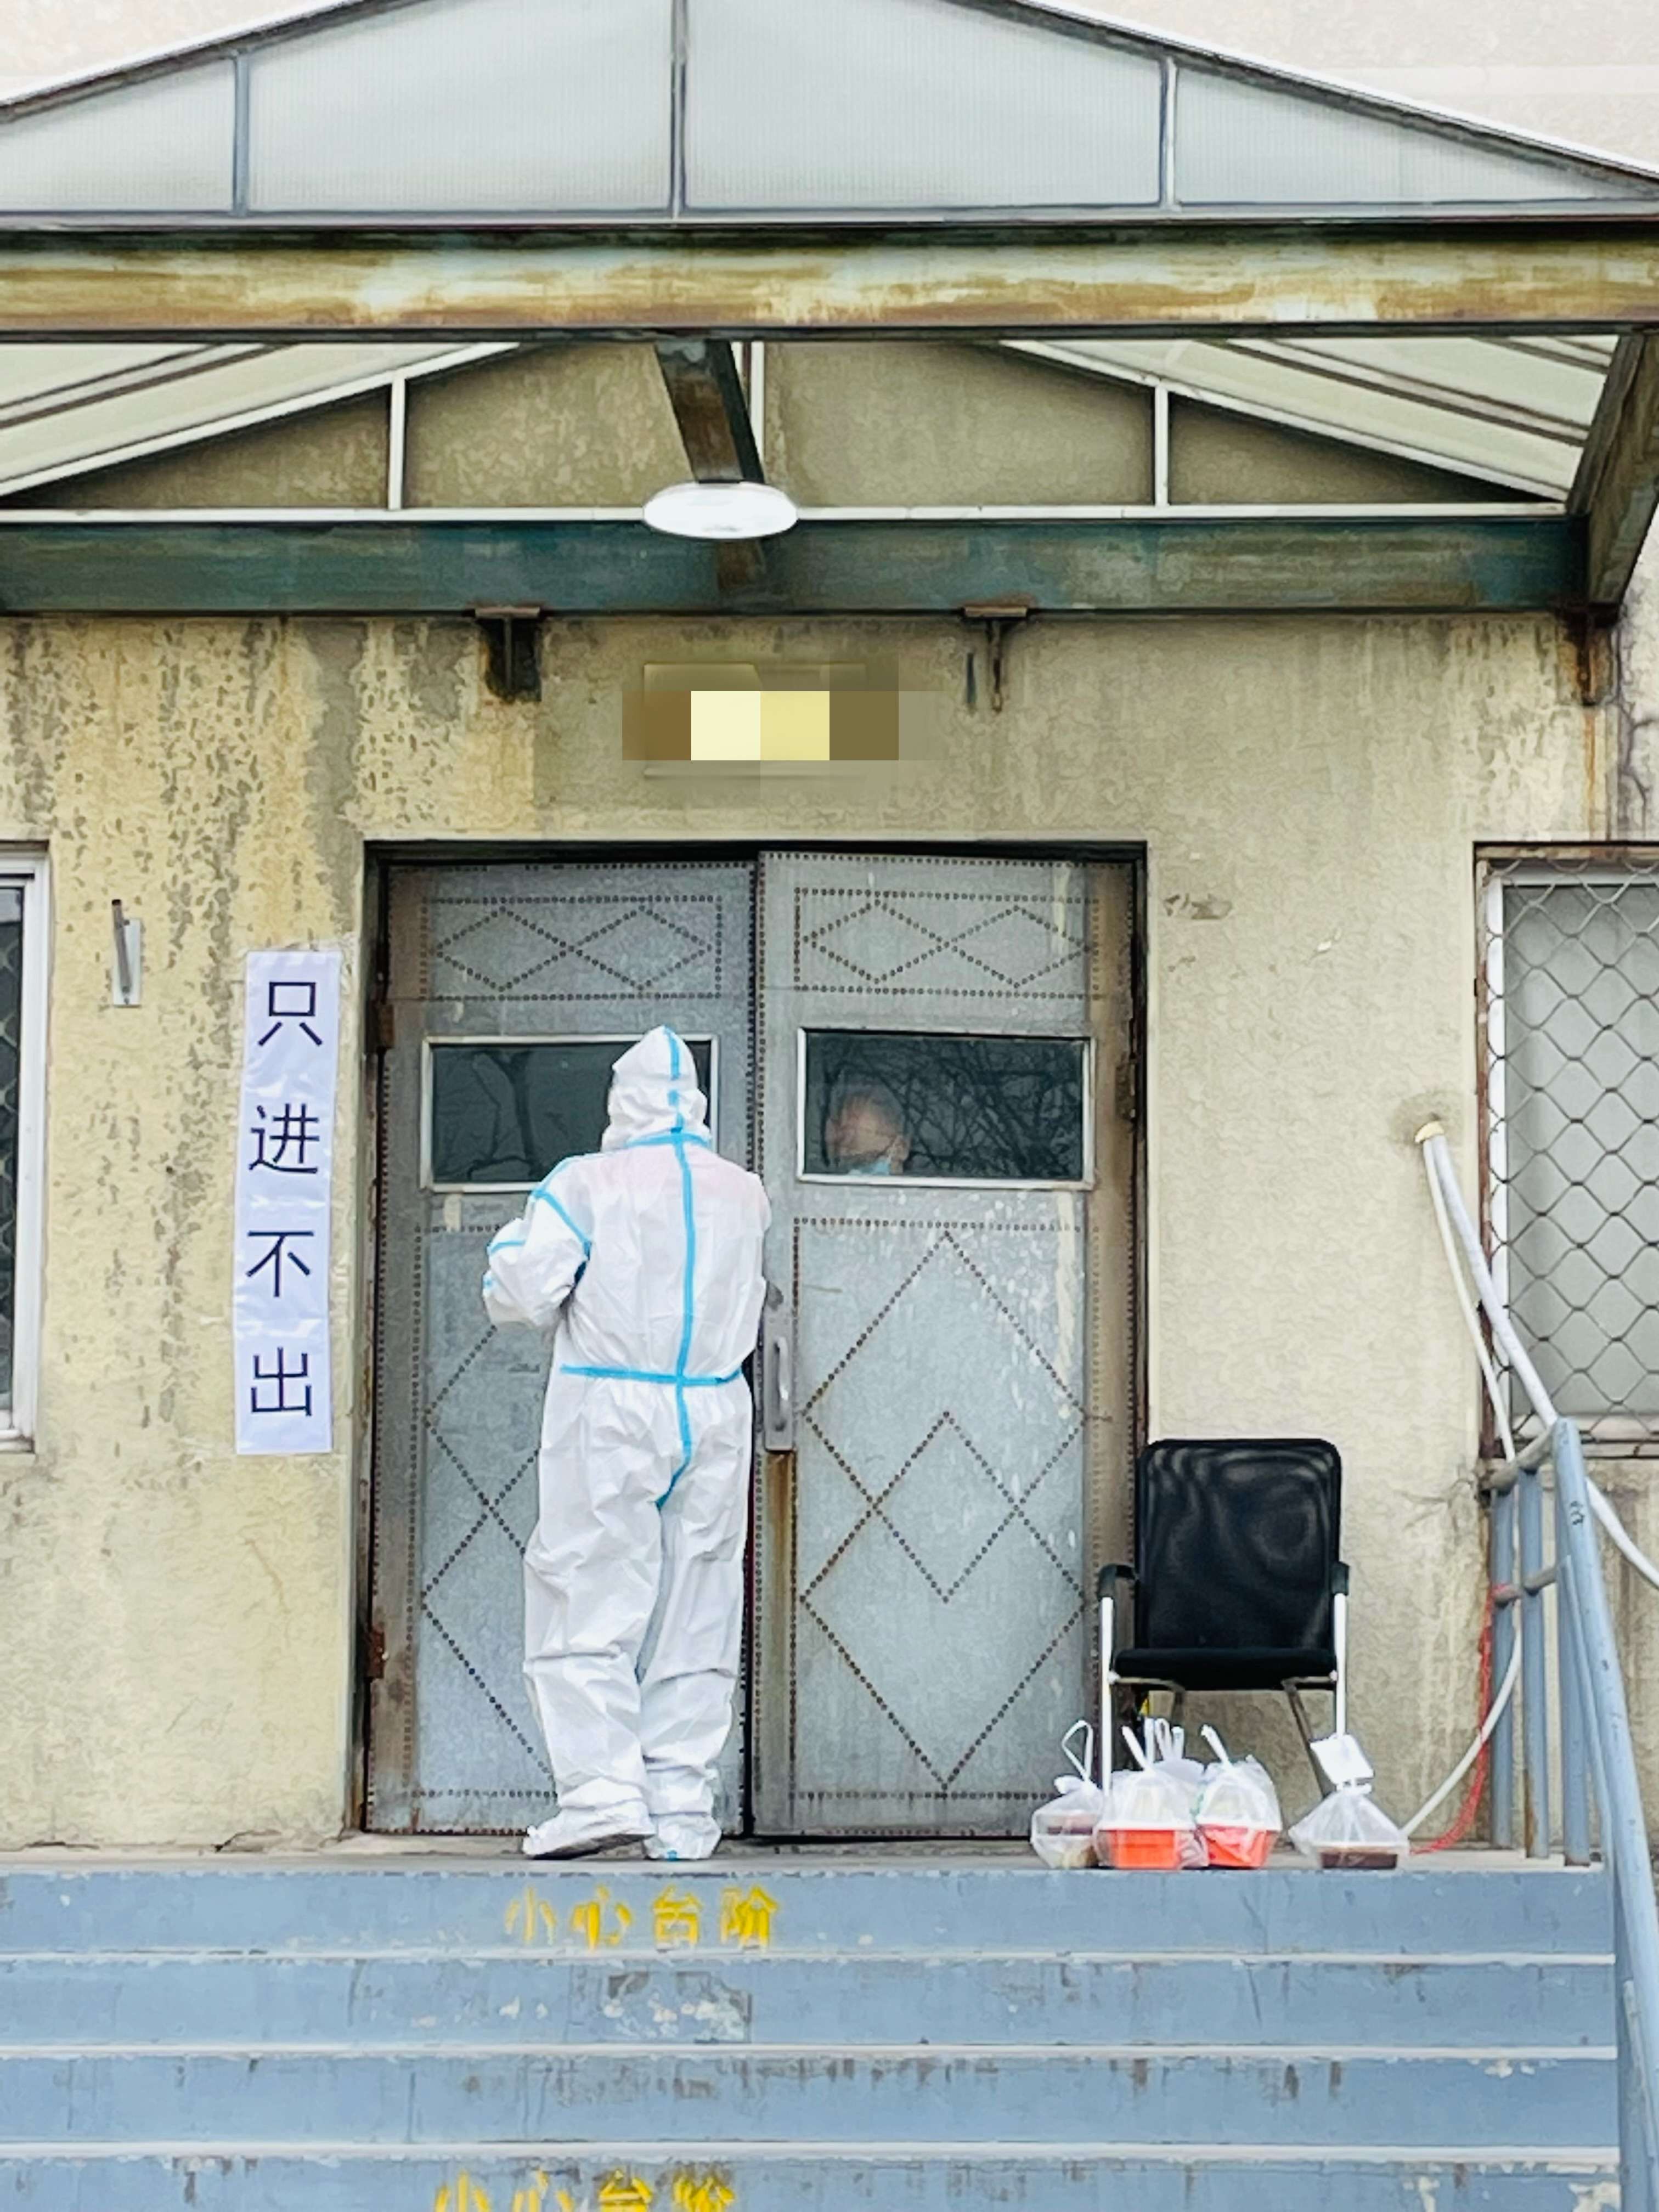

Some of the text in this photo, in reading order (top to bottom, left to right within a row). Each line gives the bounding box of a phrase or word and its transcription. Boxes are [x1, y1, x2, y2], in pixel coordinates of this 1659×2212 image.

[246, 980, 323, 1417] 只进不出
[505, 1884, 778, 1952] 小心台阶
